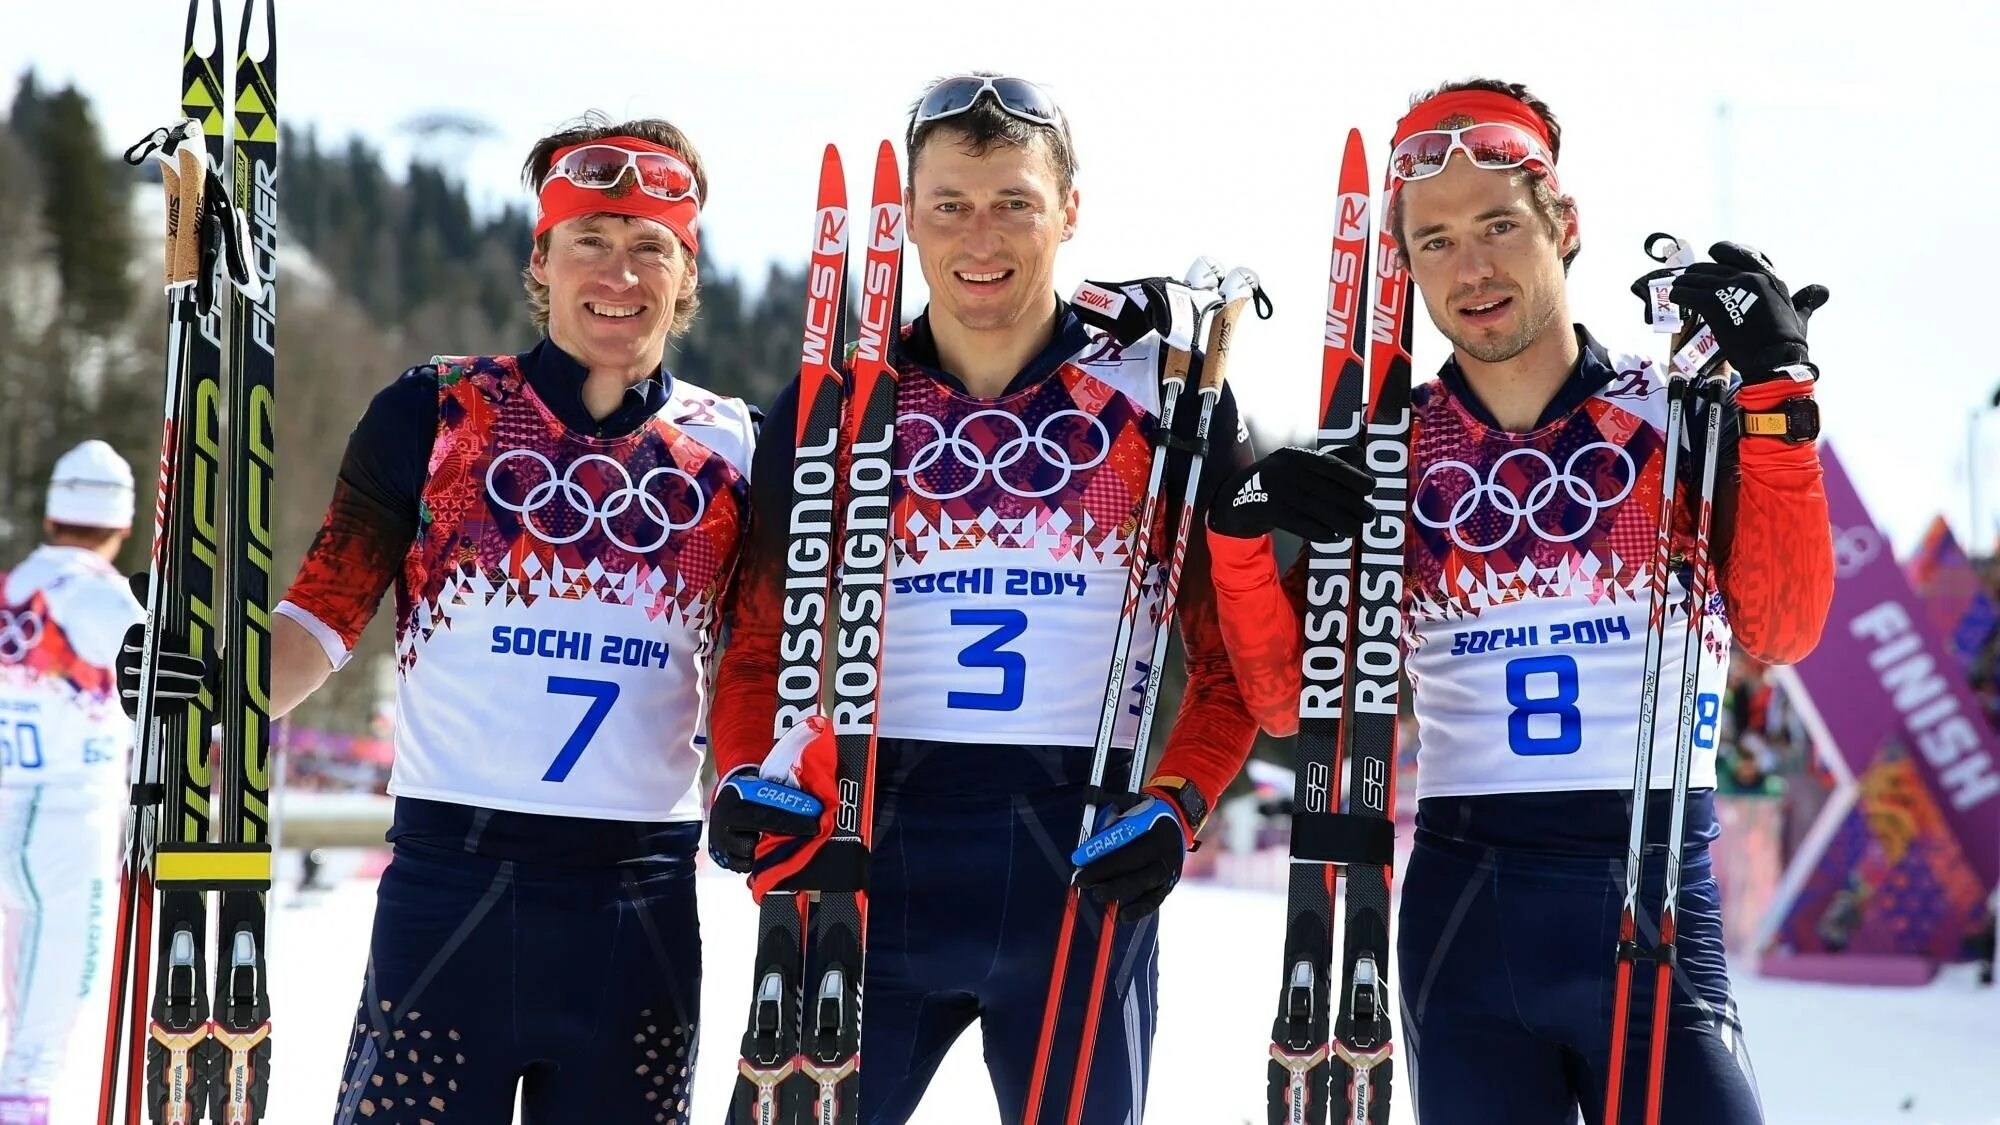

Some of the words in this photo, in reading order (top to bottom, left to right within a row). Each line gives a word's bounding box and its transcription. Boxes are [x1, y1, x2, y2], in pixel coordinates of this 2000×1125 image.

[253, 158, 276, 356] FISCHER
[801, 263, 836, 366] WCS
[857, 260, 891, 361] WCS
[1324, 248, 1357, 349] WCS
[1715, 288, 1744, 326] adidas
[1233, 490, 1268, 507] adidas
[774, 428, 838, 740] ROSSIGNOL
[833, 424, 894, 735] ROSSIGNOL
[891, 567, 994, 595] SOCHI
[1005, 568, 1088, 597] 2014
[491, 625, 593, 661] SOCHI
[600, 635, 670, 670] 2014
[947, 608, 1028, 712] 3
[1450, 625, 1539, 656] SOCHI
[1550, 615, 1631, 645] 2014
[1109, 656, 1124, 689] TRIAC
[1147, 665, 1160, 696] TRIAC
[1643, 670, 1655, 703] TRIAC
[1684, 672, 1695, 705] TRIAC
[542, 676, 620, 783] 7
[1506, 655, 1582, 756] 8
[1694, 693, 1719, 749] 8
[1850, 600, 2000, 814] FINISH
[757, 787, 803, 808] CRAFT
[837, 778, 858, 832] S2
[1364, 757, 1384, 811] S2
[1086, 827, 1124, 858] CRAFT
